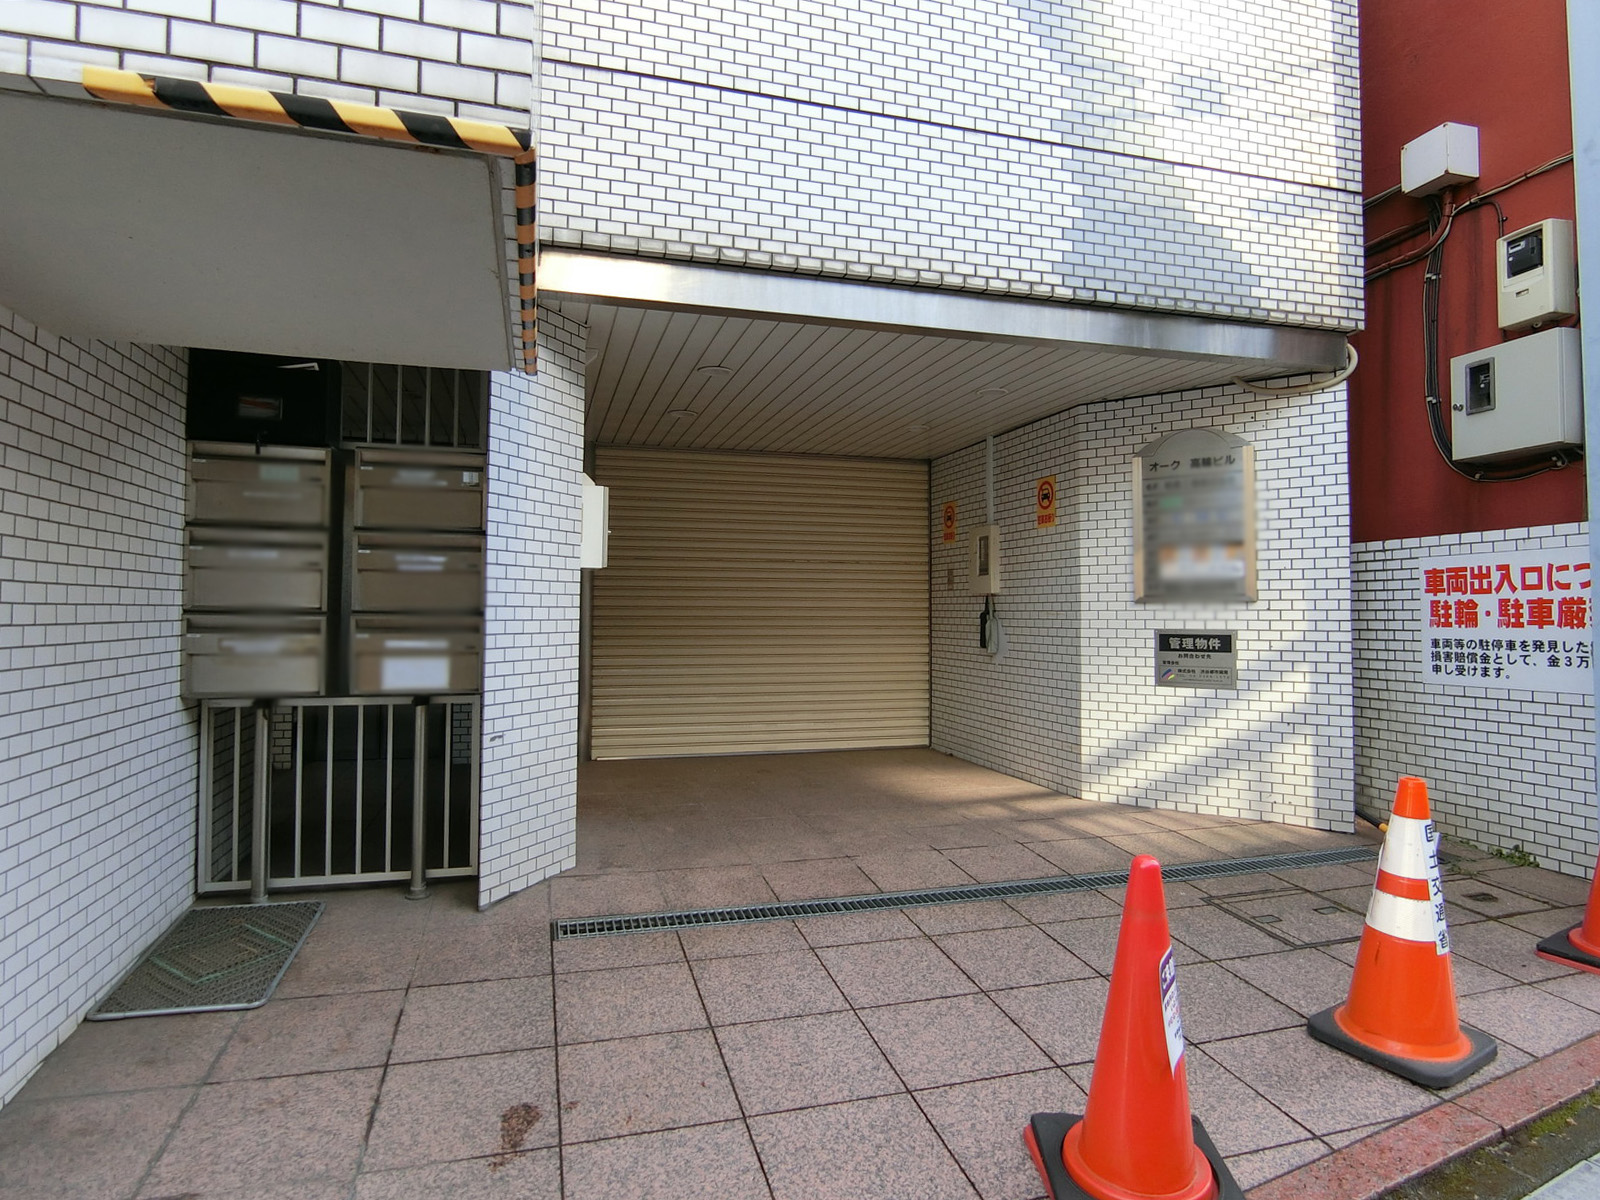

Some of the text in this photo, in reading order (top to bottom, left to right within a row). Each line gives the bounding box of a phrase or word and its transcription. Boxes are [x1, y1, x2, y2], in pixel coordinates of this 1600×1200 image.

[1149, 460, 1181, 472] オーク
[1423, 562, 1592, 597] 車両出入口につ
[1429, 596, 1593, 630] 駐輪・駐車厳
[1168, 637, 1222, 651] 管理物件
[1430, 637, 1594, 653] 車両等の駐停車を発見した
[1430, 651, 1594, 669] 損害賠償金として、金3万
[1431, 664, 1511, 680] 申し受けます。
